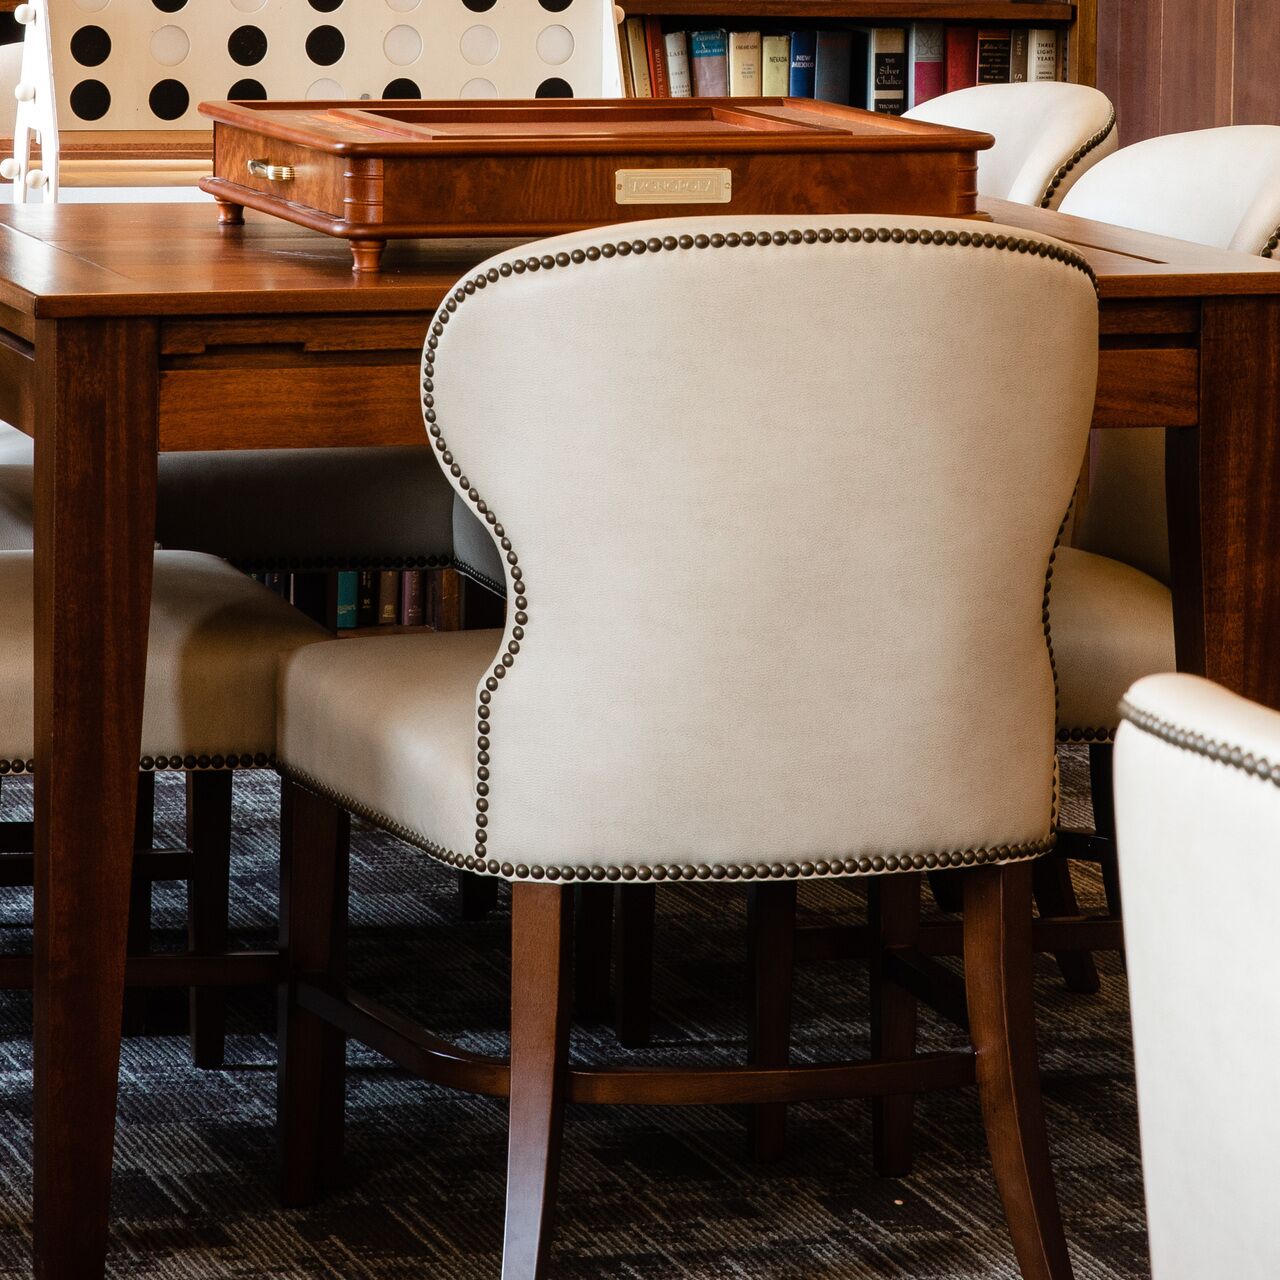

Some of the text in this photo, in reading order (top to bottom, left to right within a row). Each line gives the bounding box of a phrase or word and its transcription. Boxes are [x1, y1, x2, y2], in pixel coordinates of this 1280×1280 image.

[795, 54, 810, 62] NEW
[879, 66, 900, 76] Silver
[876, 76, 903, 87] Chalice
